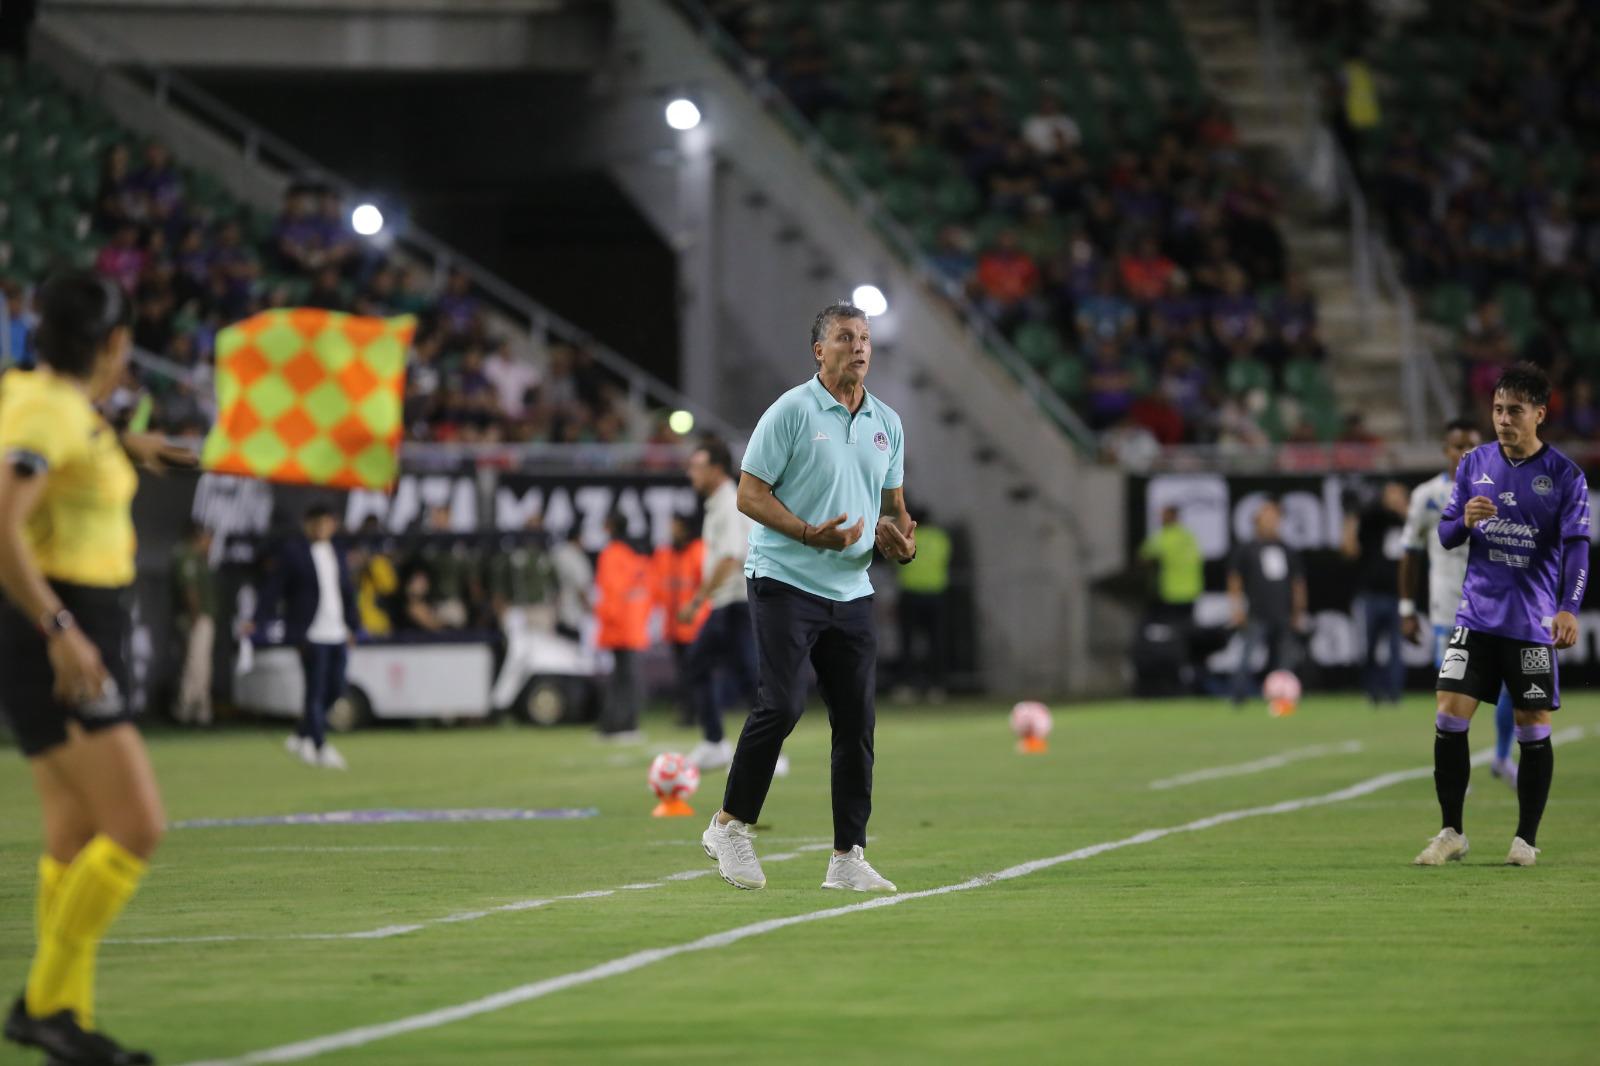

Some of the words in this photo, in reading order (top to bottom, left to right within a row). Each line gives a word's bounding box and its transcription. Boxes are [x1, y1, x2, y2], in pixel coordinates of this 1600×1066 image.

[1571, 568, 1586, 601] PIRMA
[1449, 625, 1469, 645] 31
[1524, 649, 1548, 660] ADE
[1524, 658, 1549, 669] 1000
